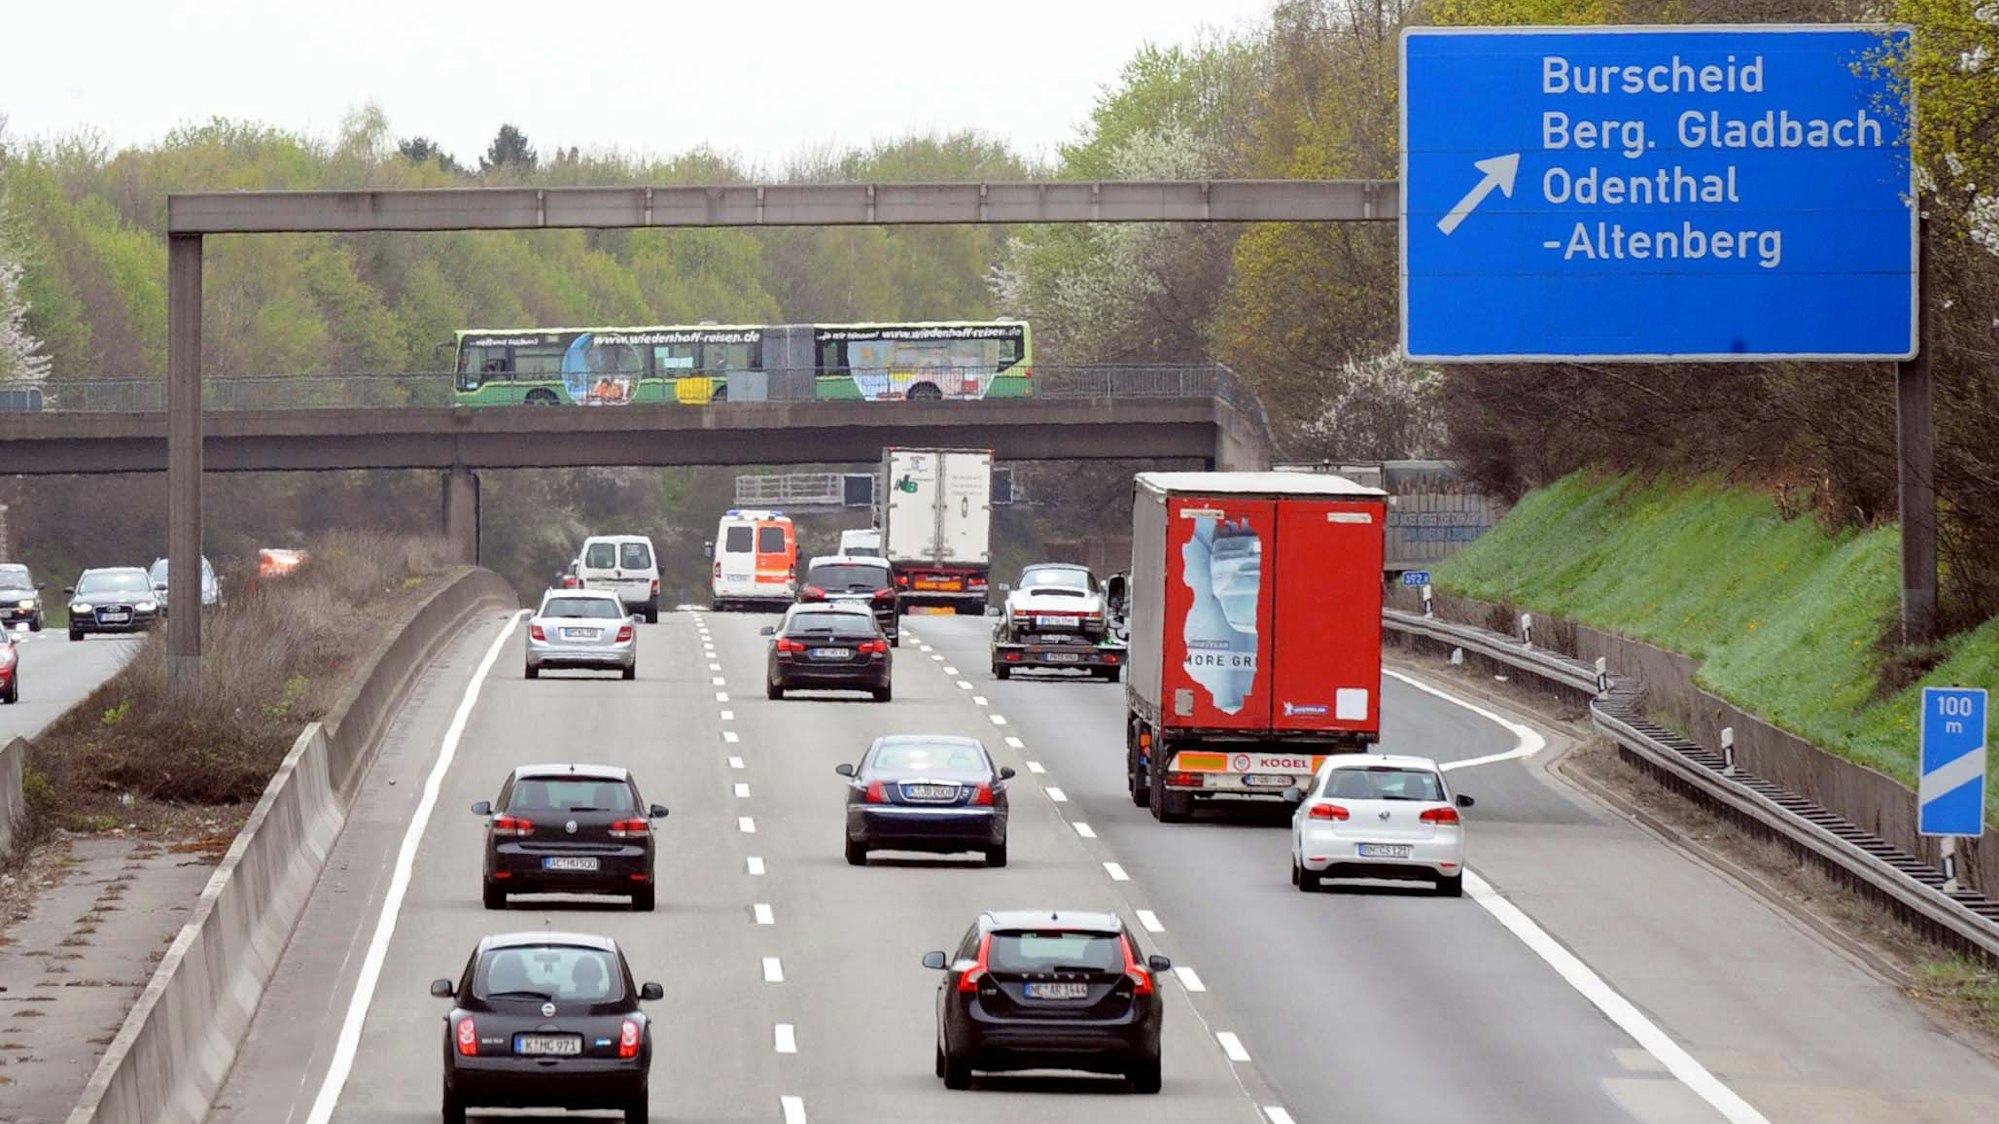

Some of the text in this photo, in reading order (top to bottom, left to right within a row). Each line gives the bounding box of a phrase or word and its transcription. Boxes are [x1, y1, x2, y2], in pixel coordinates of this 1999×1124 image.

[1542, 55, 1764, 94] Burscheid
[1542, 109, 1883, 158] Berg. Gladbach
[1543, 165, 1740, 204] Odenthal
[1542, 221, 1783, 268] -Altenberg
[593, 330, 760, 345] www.wiedenhoff-reisen.de
[1232, 655, 1259, 667] GR
[1937, 695, 1973, 716] 100
[1945, 720, 1963, 734] m
